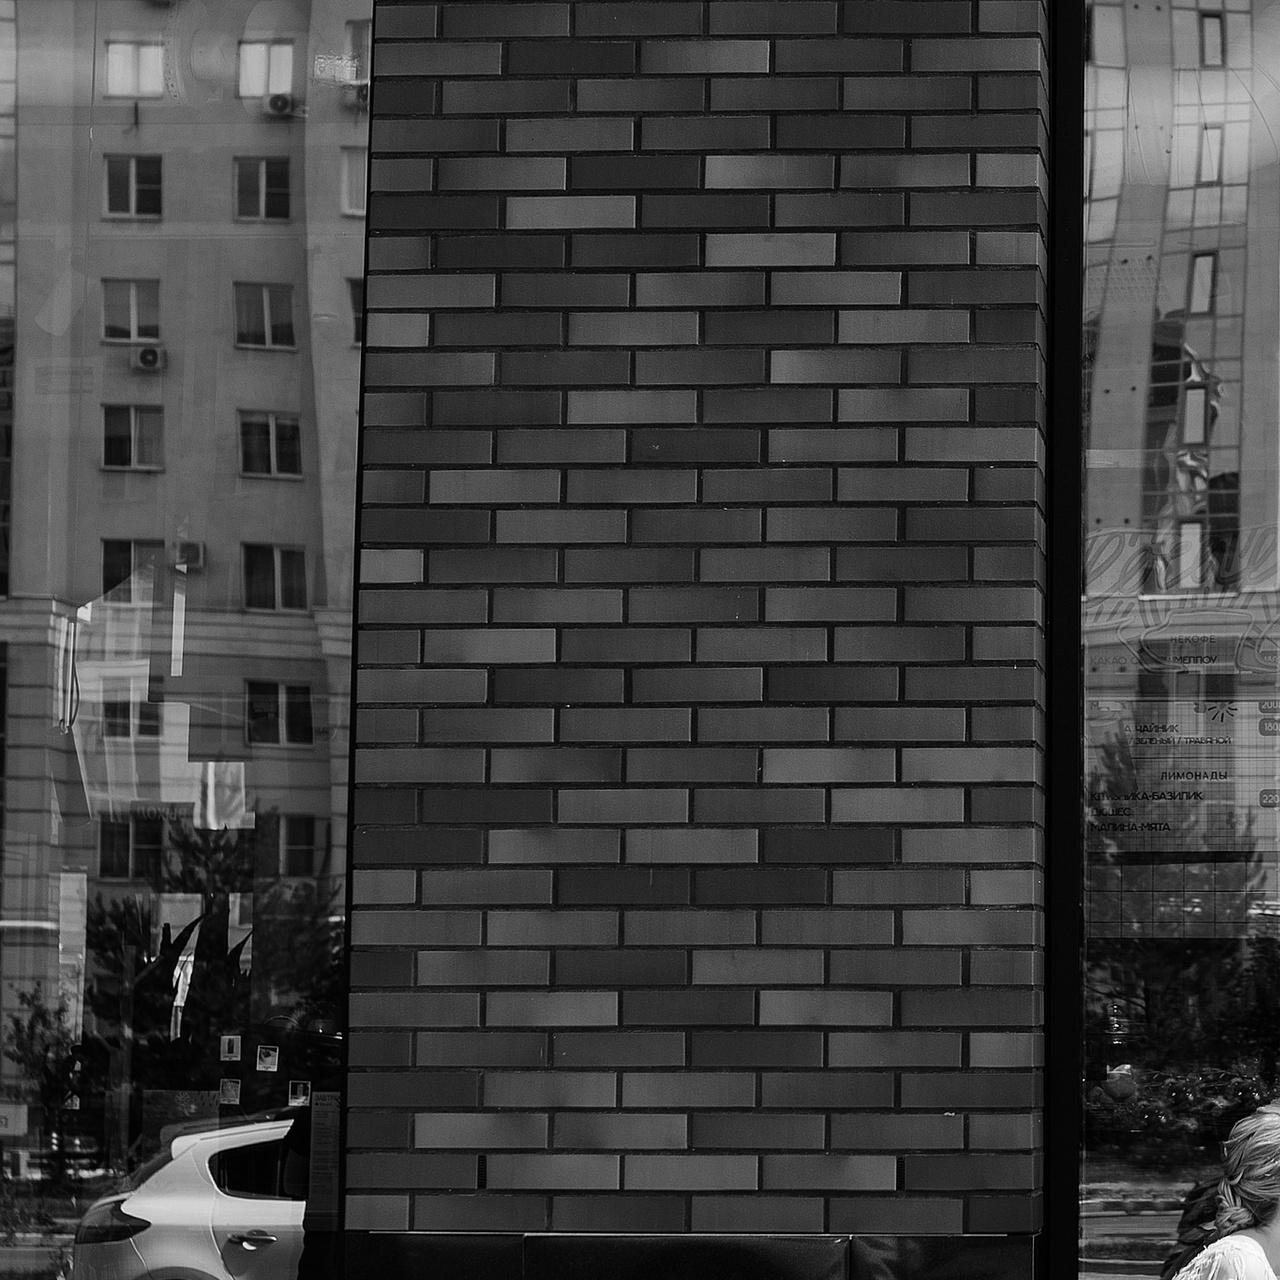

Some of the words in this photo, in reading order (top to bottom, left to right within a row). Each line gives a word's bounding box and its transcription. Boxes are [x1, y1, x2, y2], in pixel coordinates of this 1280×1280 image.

[1090, 656, 1128, 666] КАКАО
[1135, 722, 1179, 733] ЧАЙНИК
[1160, 771, 1228, 781] ЛИМОНАДЫ
[1090, 822, 1171, 832] МАЛИНА-МЯТА
